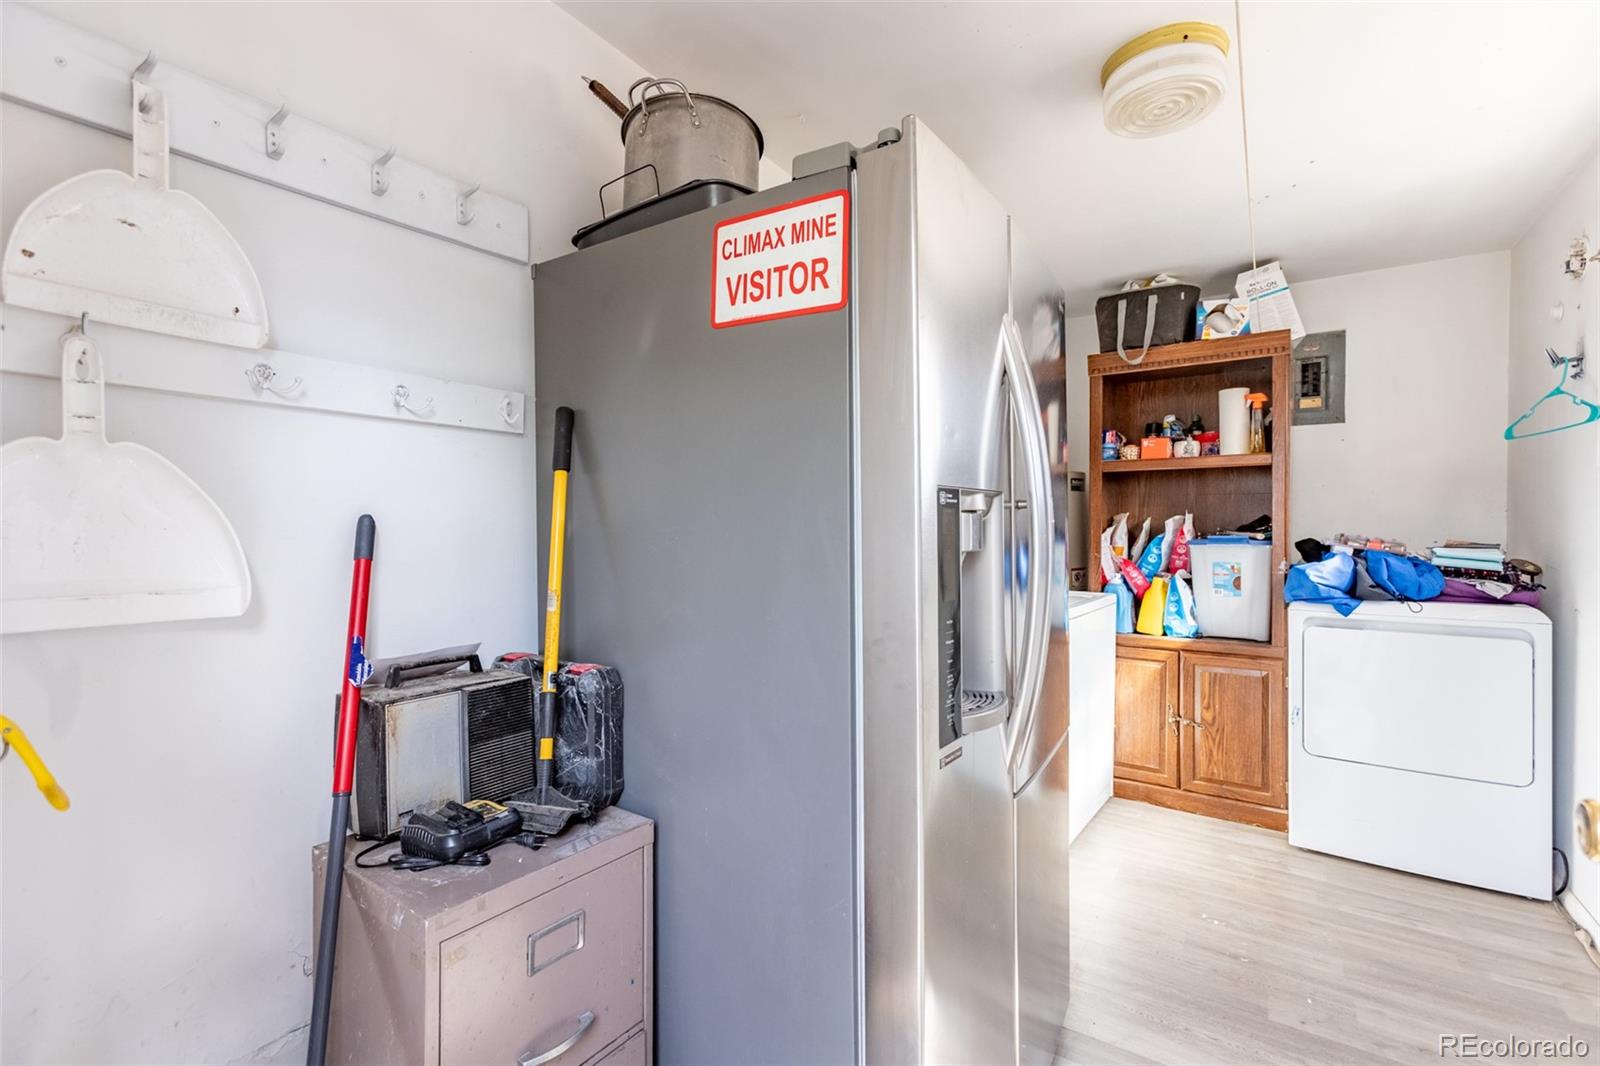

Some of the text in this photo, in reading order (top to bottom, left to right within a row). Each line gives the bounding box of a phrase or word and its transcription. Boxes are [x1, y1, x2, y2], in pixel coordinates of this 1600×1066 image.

[721, 213, 837, 260] CLIMAX MINE
[726, 257, 829, 306] VISITOR
